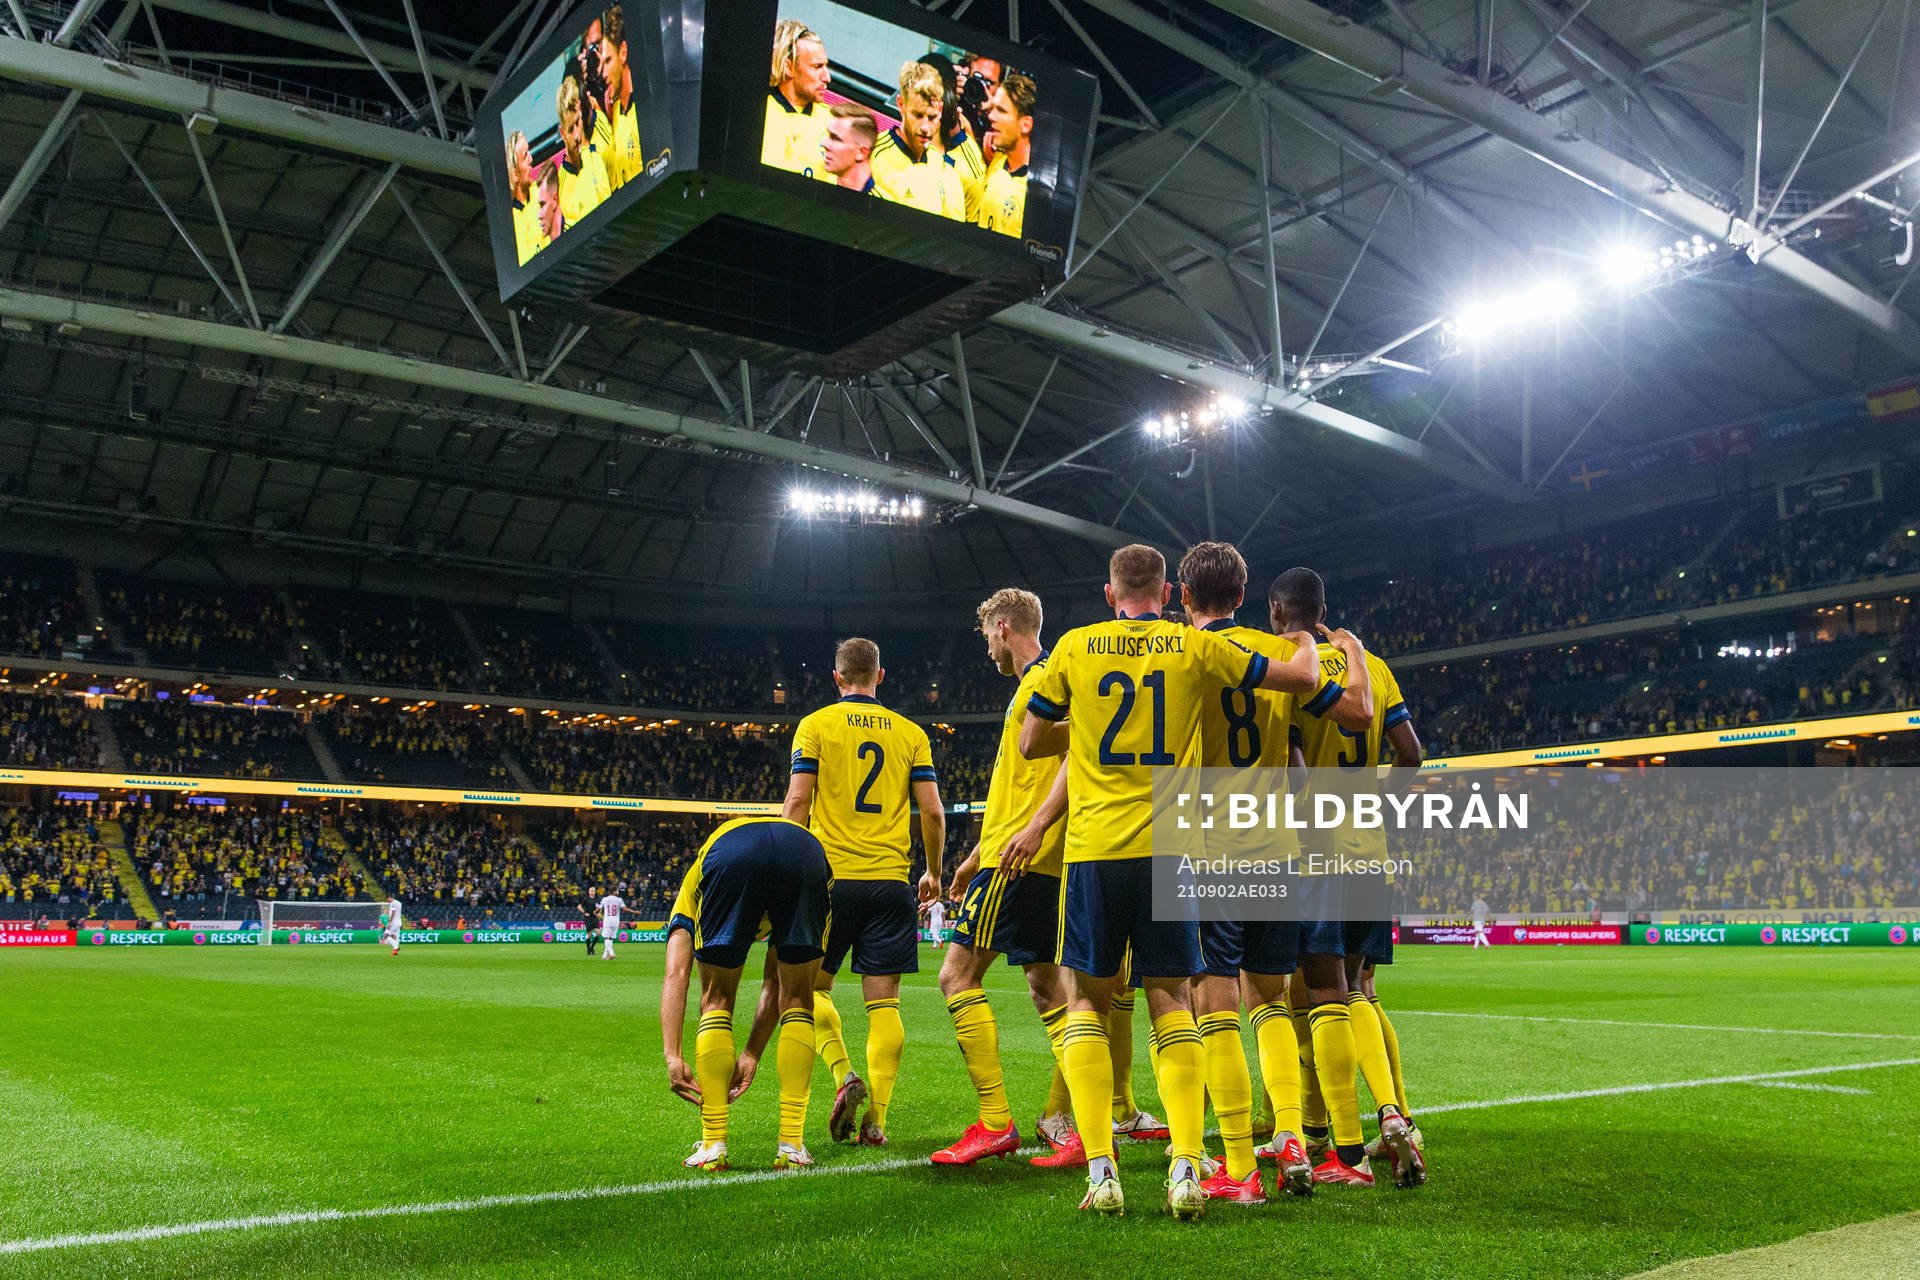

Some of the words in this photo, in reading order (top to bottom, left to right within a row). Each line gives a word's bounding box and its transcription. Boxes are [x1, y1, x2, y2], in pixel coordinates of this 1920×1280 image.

[1087, 635, 1184, 657] KULUSEVSKI
[846, 713, 892, 731] KRAFTH
[1097, 670, 1175, 766] 21
[1220, 686, 1262, 768] 8
[855, 741, 885, 814] 2
[954, 803, 968, 813] ESP
[606, 904, 617, 917] 18
[8, 935, 68, 943] BAUHAUS
[109, 932, 166, 943] RESPECT
[210, 933, 263, 943] RESPECT
[304, 933, 354, 943] RESPECT
[398, 932, 440, 942] ESPECT
[477, 932, 521, 942] RESPECT
[631, 932, 668, 941] RESPEC
[1433, 934, 1472, 943] Qualifiers
[1528, 931, 1570, 939] EUROPEAN
[1571, 931, 1617, 939] QUALIFIERS
[1664, 928, 1726, 942] RESPECT
[1781, 928, 1850, 942] RESPECT
